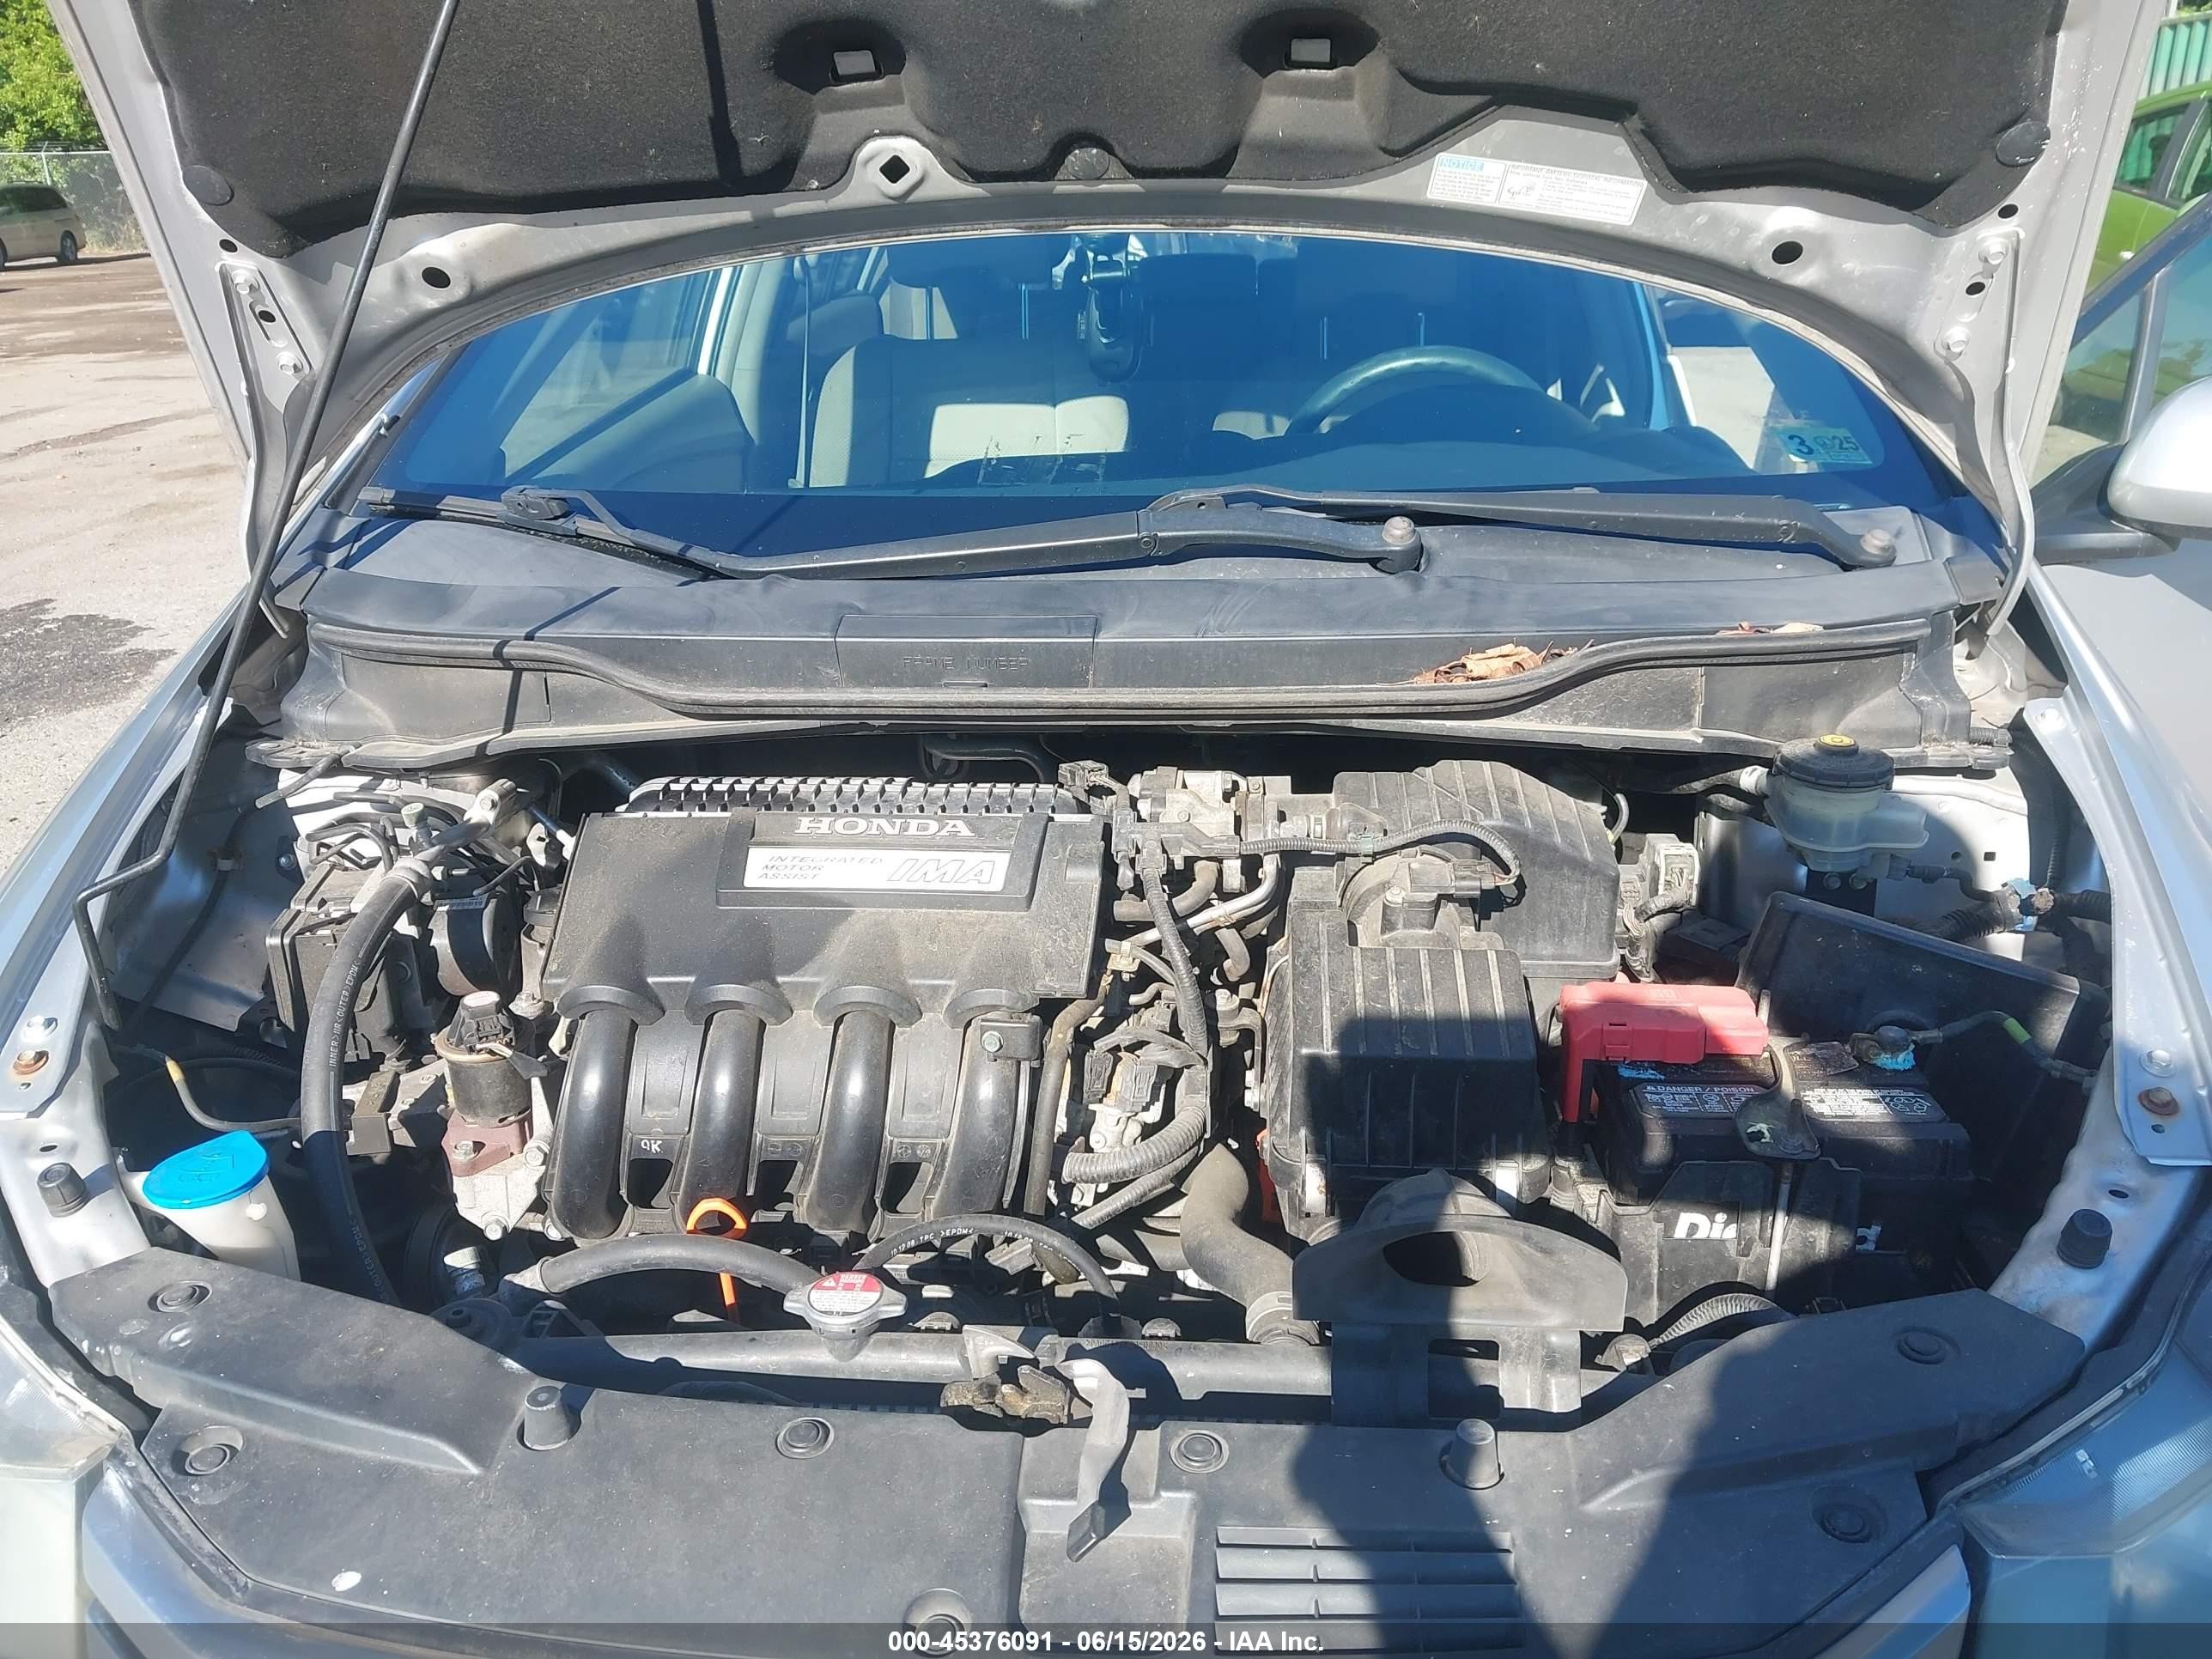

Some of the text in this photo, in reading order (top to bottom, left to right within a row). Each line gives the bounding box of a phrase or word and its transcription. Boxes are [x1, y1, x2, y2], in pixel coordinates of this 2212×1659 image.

[1442, 157, 1484, 171] NOTICE
[1788, 434, 1859, 455] 3 25
[903, 655, 1030, 670] FRAME NUMBER
[793, 817, 975, 837] HONDA
[768, 855, 995, 884] INTEGRATED IMA
